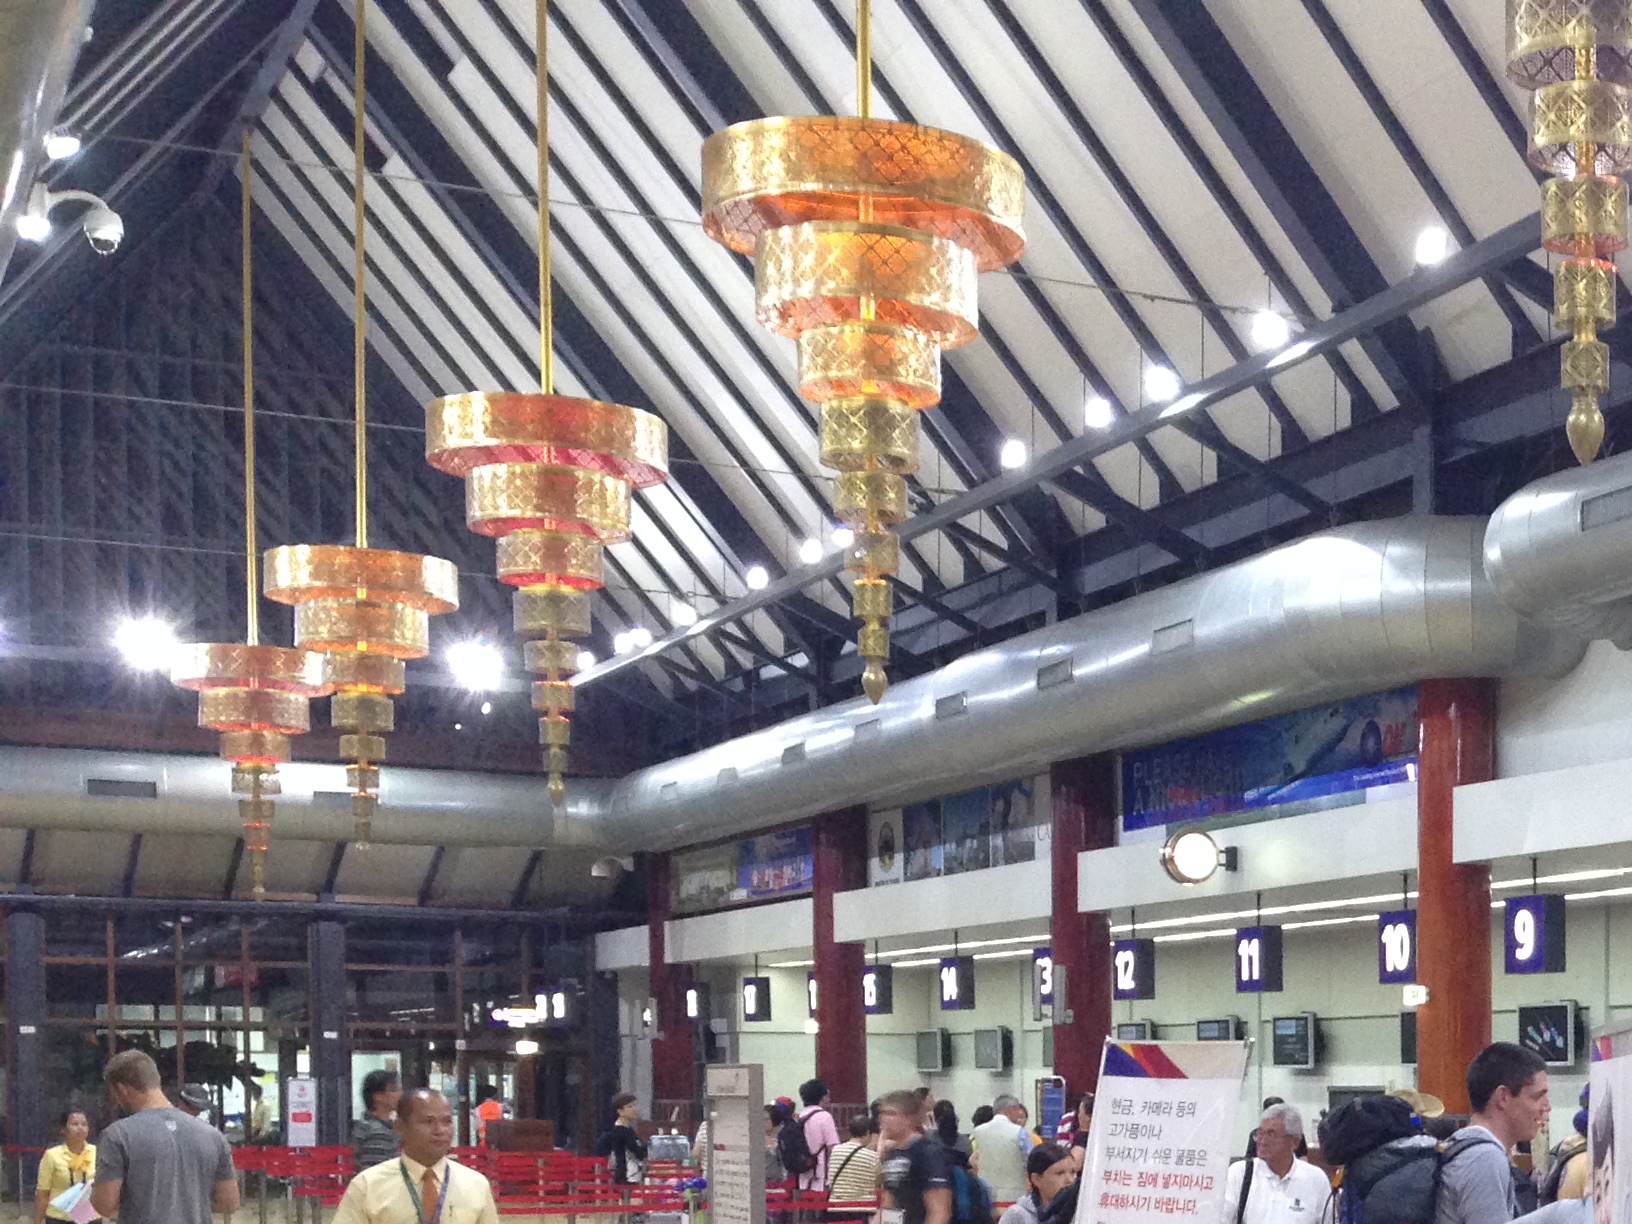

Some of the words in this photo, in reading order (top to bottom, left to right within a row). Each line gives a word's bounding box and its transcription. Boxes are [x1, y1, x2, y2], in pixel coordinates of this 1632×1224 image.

[1514, 909, 1535, 960] 9
[1381, 923, 1410, 972] 10
[1238, 938, 1260, 981] 11
[1115, 950, 1135, 990] 12
[1140, 1100, 1173, 1117] 카메라
[1175, 1101, 1197, 1117] 등의
[1108, 1123, 1162, 1140] 고가품이나
[1105, 1145, 1148, 1162] 부서지기
[1151, 1147, 1172, 1165] 쉬운
[1102, 1169, 1133, 1186] 부치는
[1137, 1171, 1158, 1188] 짐에
[1098, 1192, 1151, 1211] 휴대하시기
